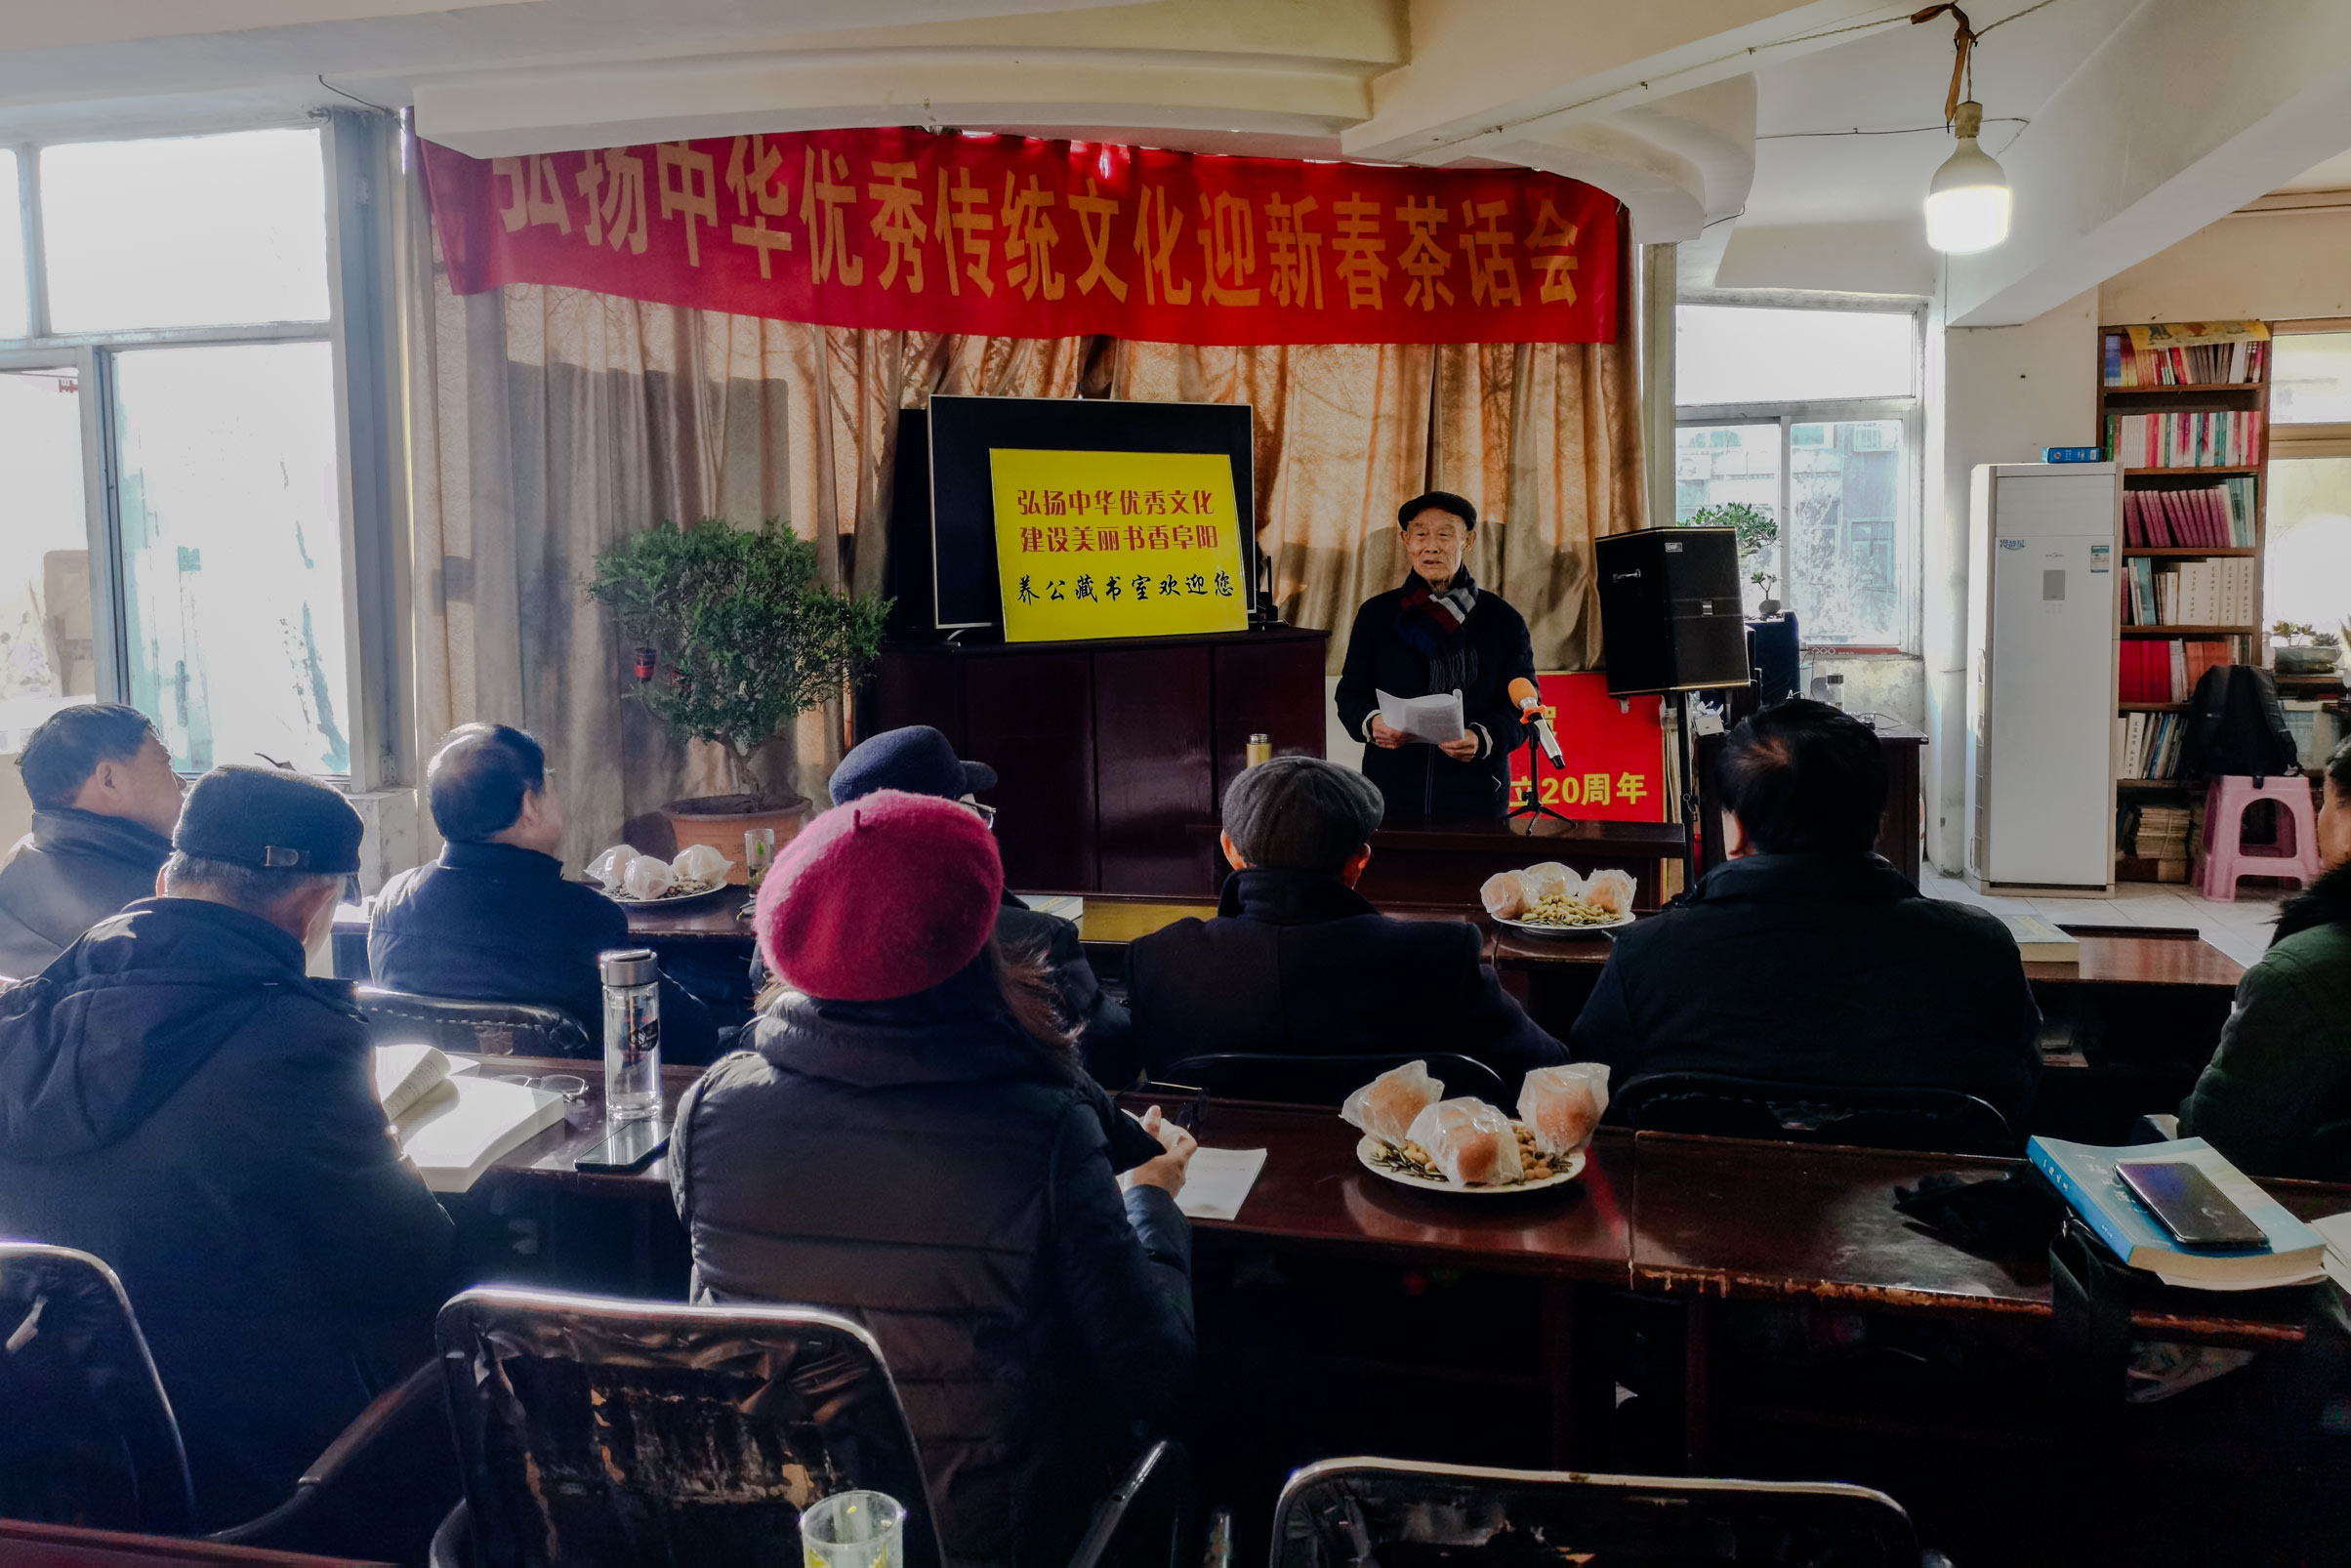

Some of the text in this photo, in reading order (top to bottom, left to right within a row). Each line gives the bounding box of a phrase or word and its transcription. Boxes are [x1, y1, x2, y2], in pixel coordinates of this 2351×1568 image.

[491, 133, 1579, 311] 弘扬中华优秀传统文化迎新春茶话会
[1016, 489, 1216, 516] 弘扬中华优秀文化
[1019, 524, 1219, 554] 建设美丽书香阜阳
[1016, 570, 1235, 606] 养公藏书室欢迎您
